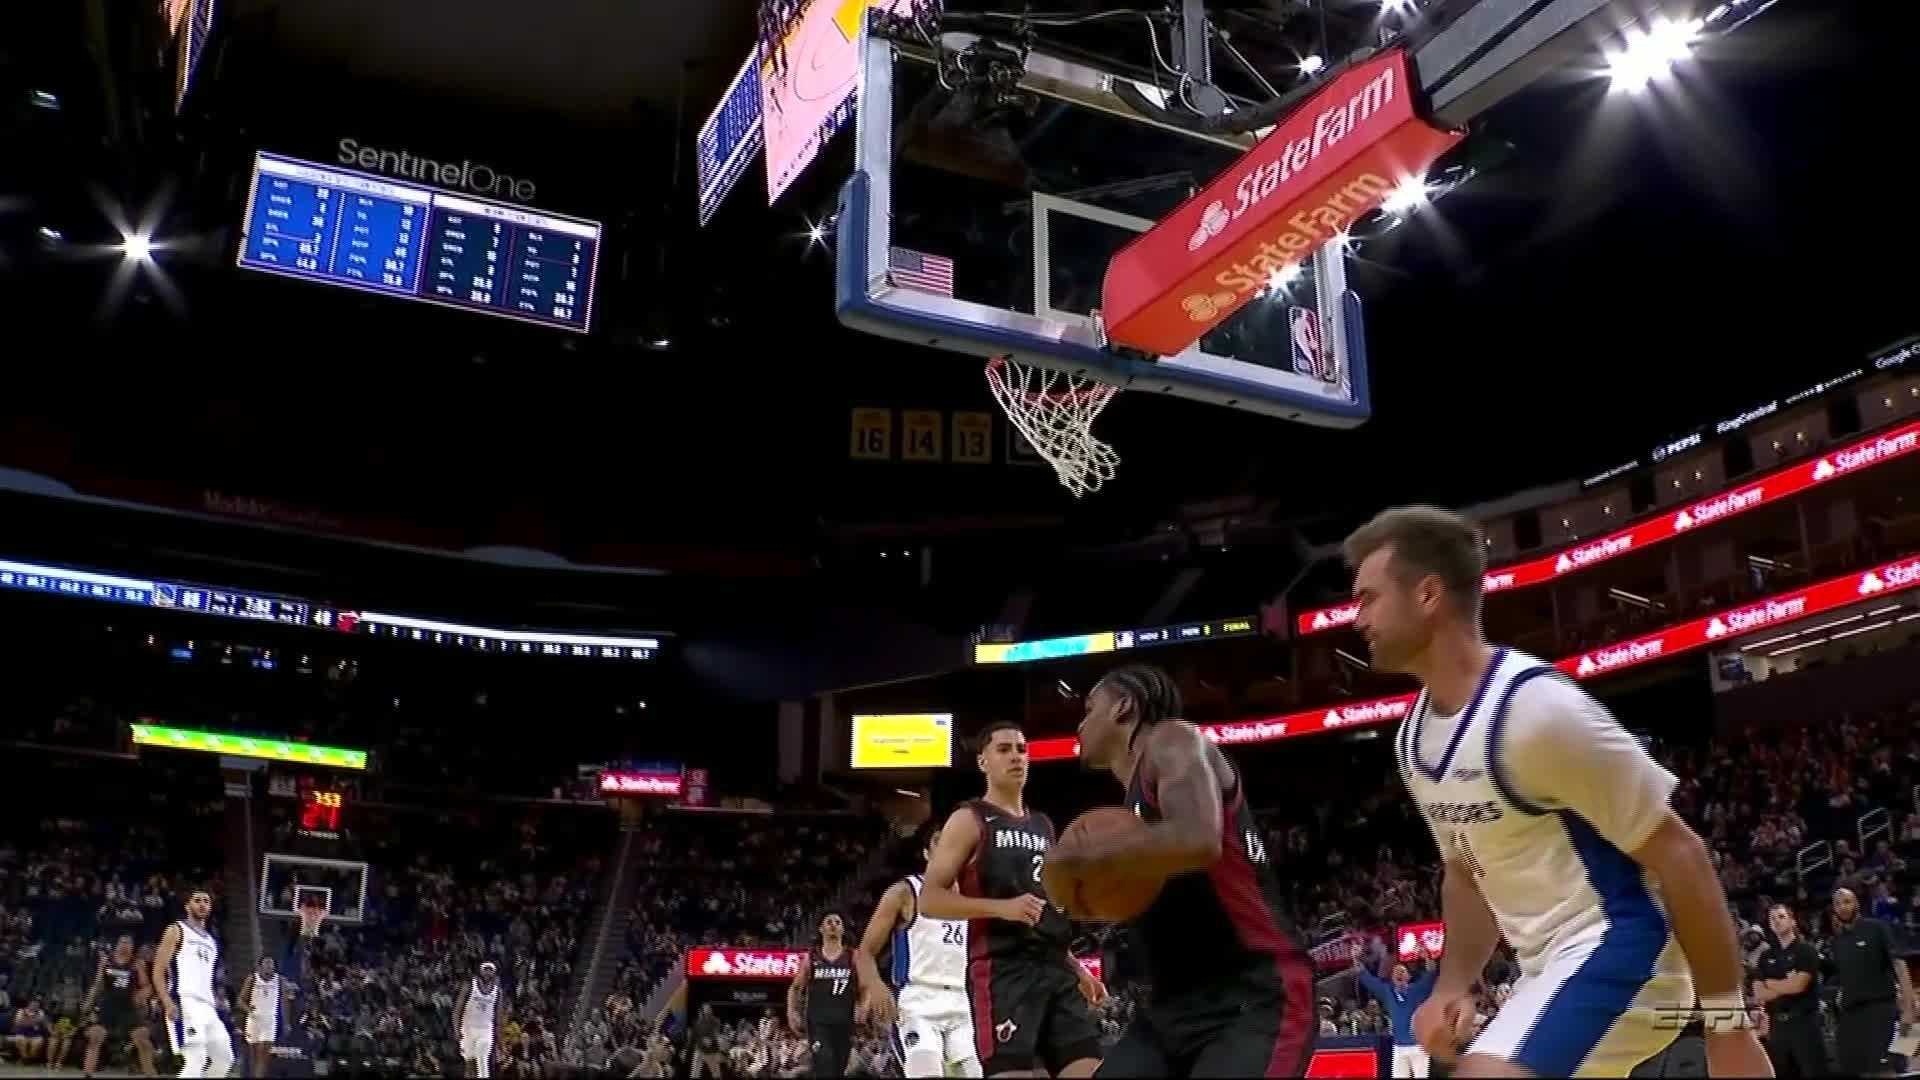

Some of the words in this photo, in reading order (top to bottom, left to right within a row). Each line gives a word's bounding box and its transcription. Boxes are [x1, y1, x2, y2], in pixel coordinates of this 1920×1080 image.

[337, 137, 536, 201] SentinelOne
[858, 428, 883, 454] 16
[909, 430, 936, 455] 14
[960, 431, 985, 456] 13
[1223, 622, 1251, 634] FINAL
[994, 829, 1048, 852] MIAM
[942, 921, 964, 945] 26
[814, 967, 851, 980] MIAMI
[831, 979, 849, 996] 17
